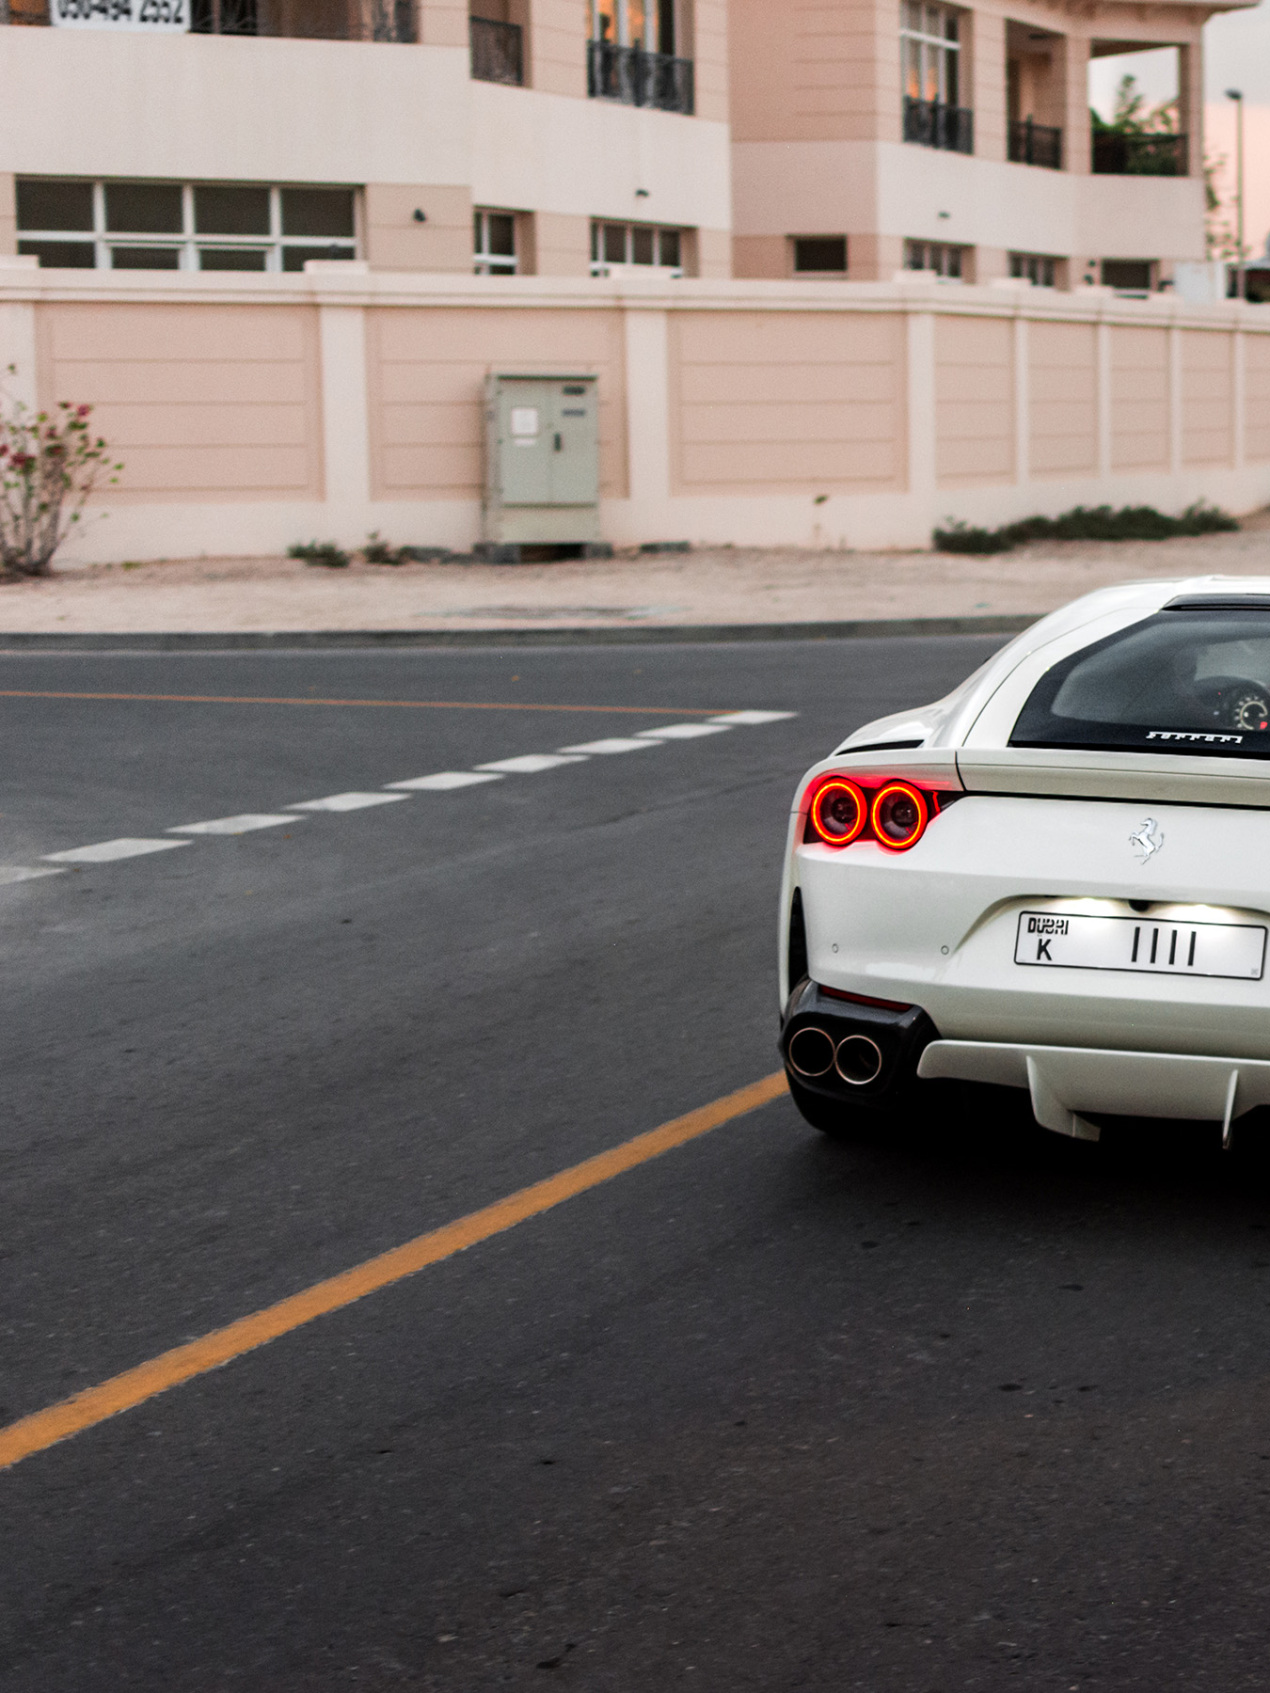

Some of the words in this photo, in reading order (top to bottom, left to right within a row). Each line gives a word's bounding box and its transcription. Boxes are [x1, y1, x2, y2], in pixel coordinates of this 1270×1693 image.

[1027, 917, 1069, 936] DUBAI
[1036, 938, 1053, 961] K
[1131, 926, 1197, 967] 1111
